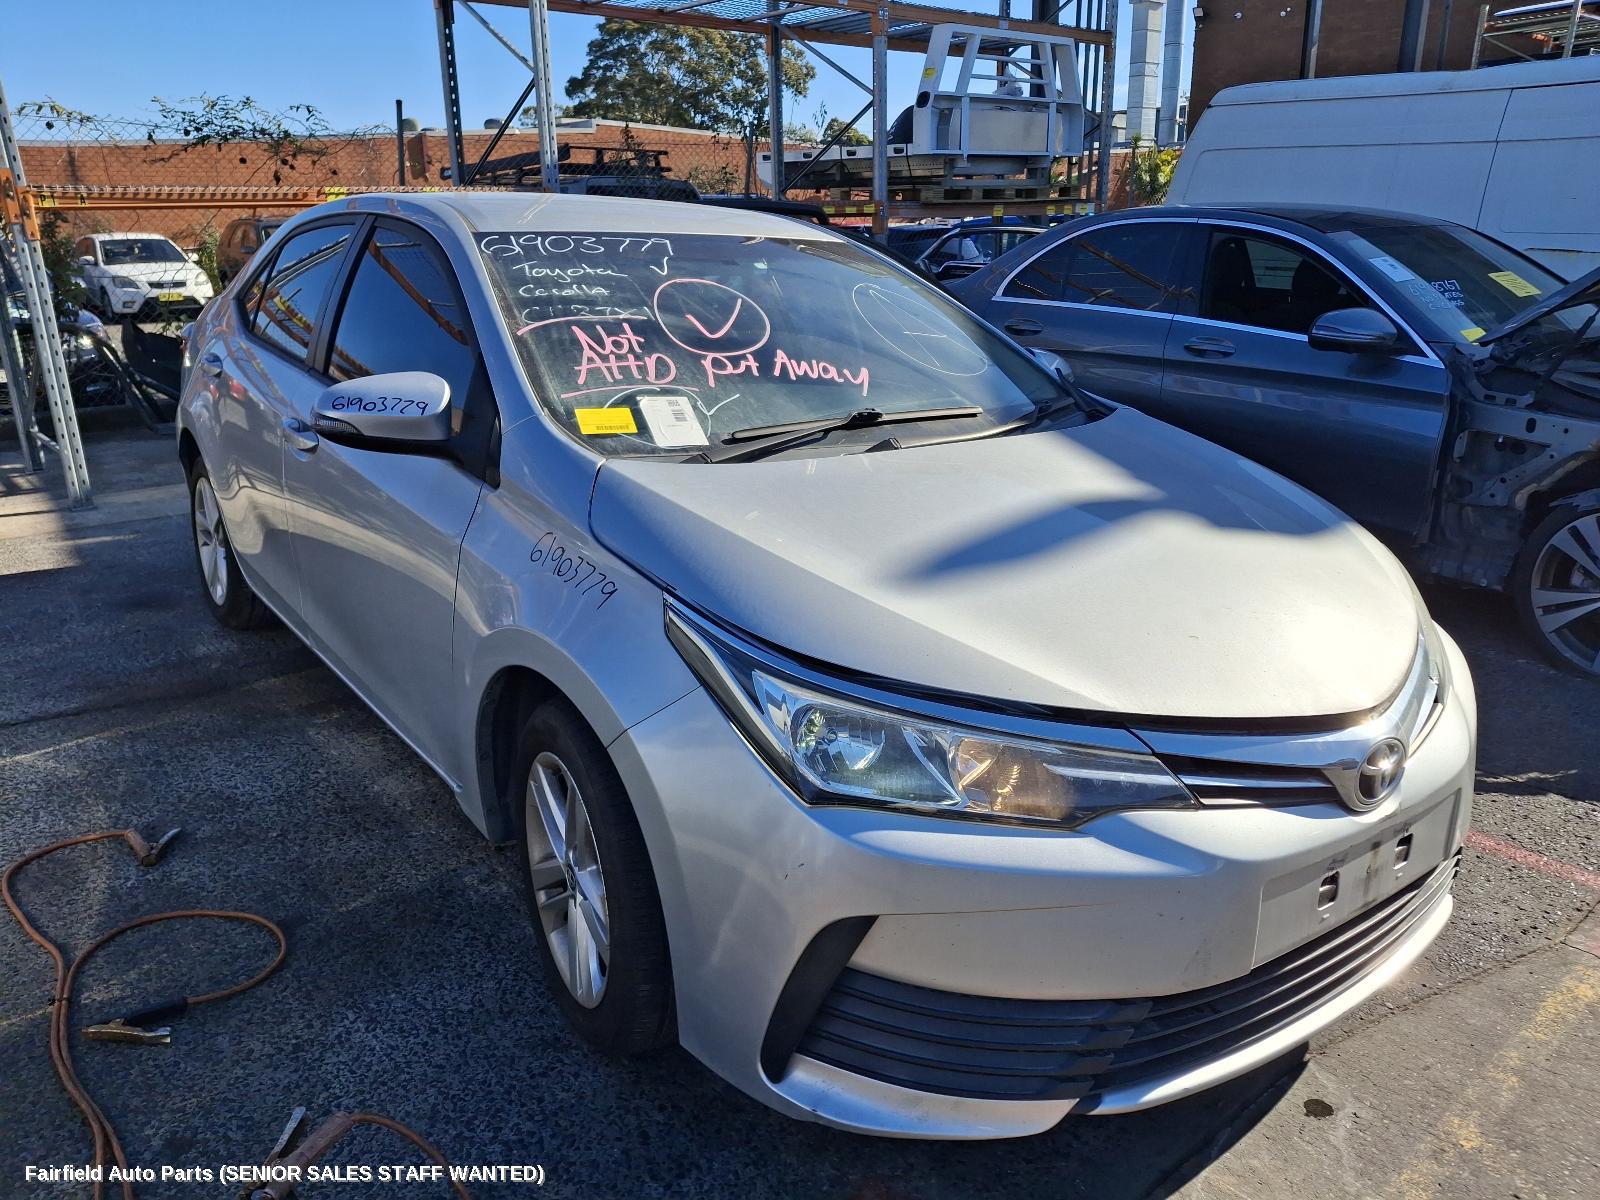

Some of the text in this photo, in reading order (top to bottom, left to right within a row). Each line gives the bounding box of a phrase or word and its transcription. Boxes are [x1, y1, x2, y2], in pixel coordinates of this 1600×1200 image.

[480, 234, 675, 257] 61903779
[512, 260, 629, 283] Toyota
[572, 322, 646, 356] Not
[773, 349, 870, 397] Away
[331, 396, 429, 415] 61903779
[530, 532, 618, 610] 61903779
